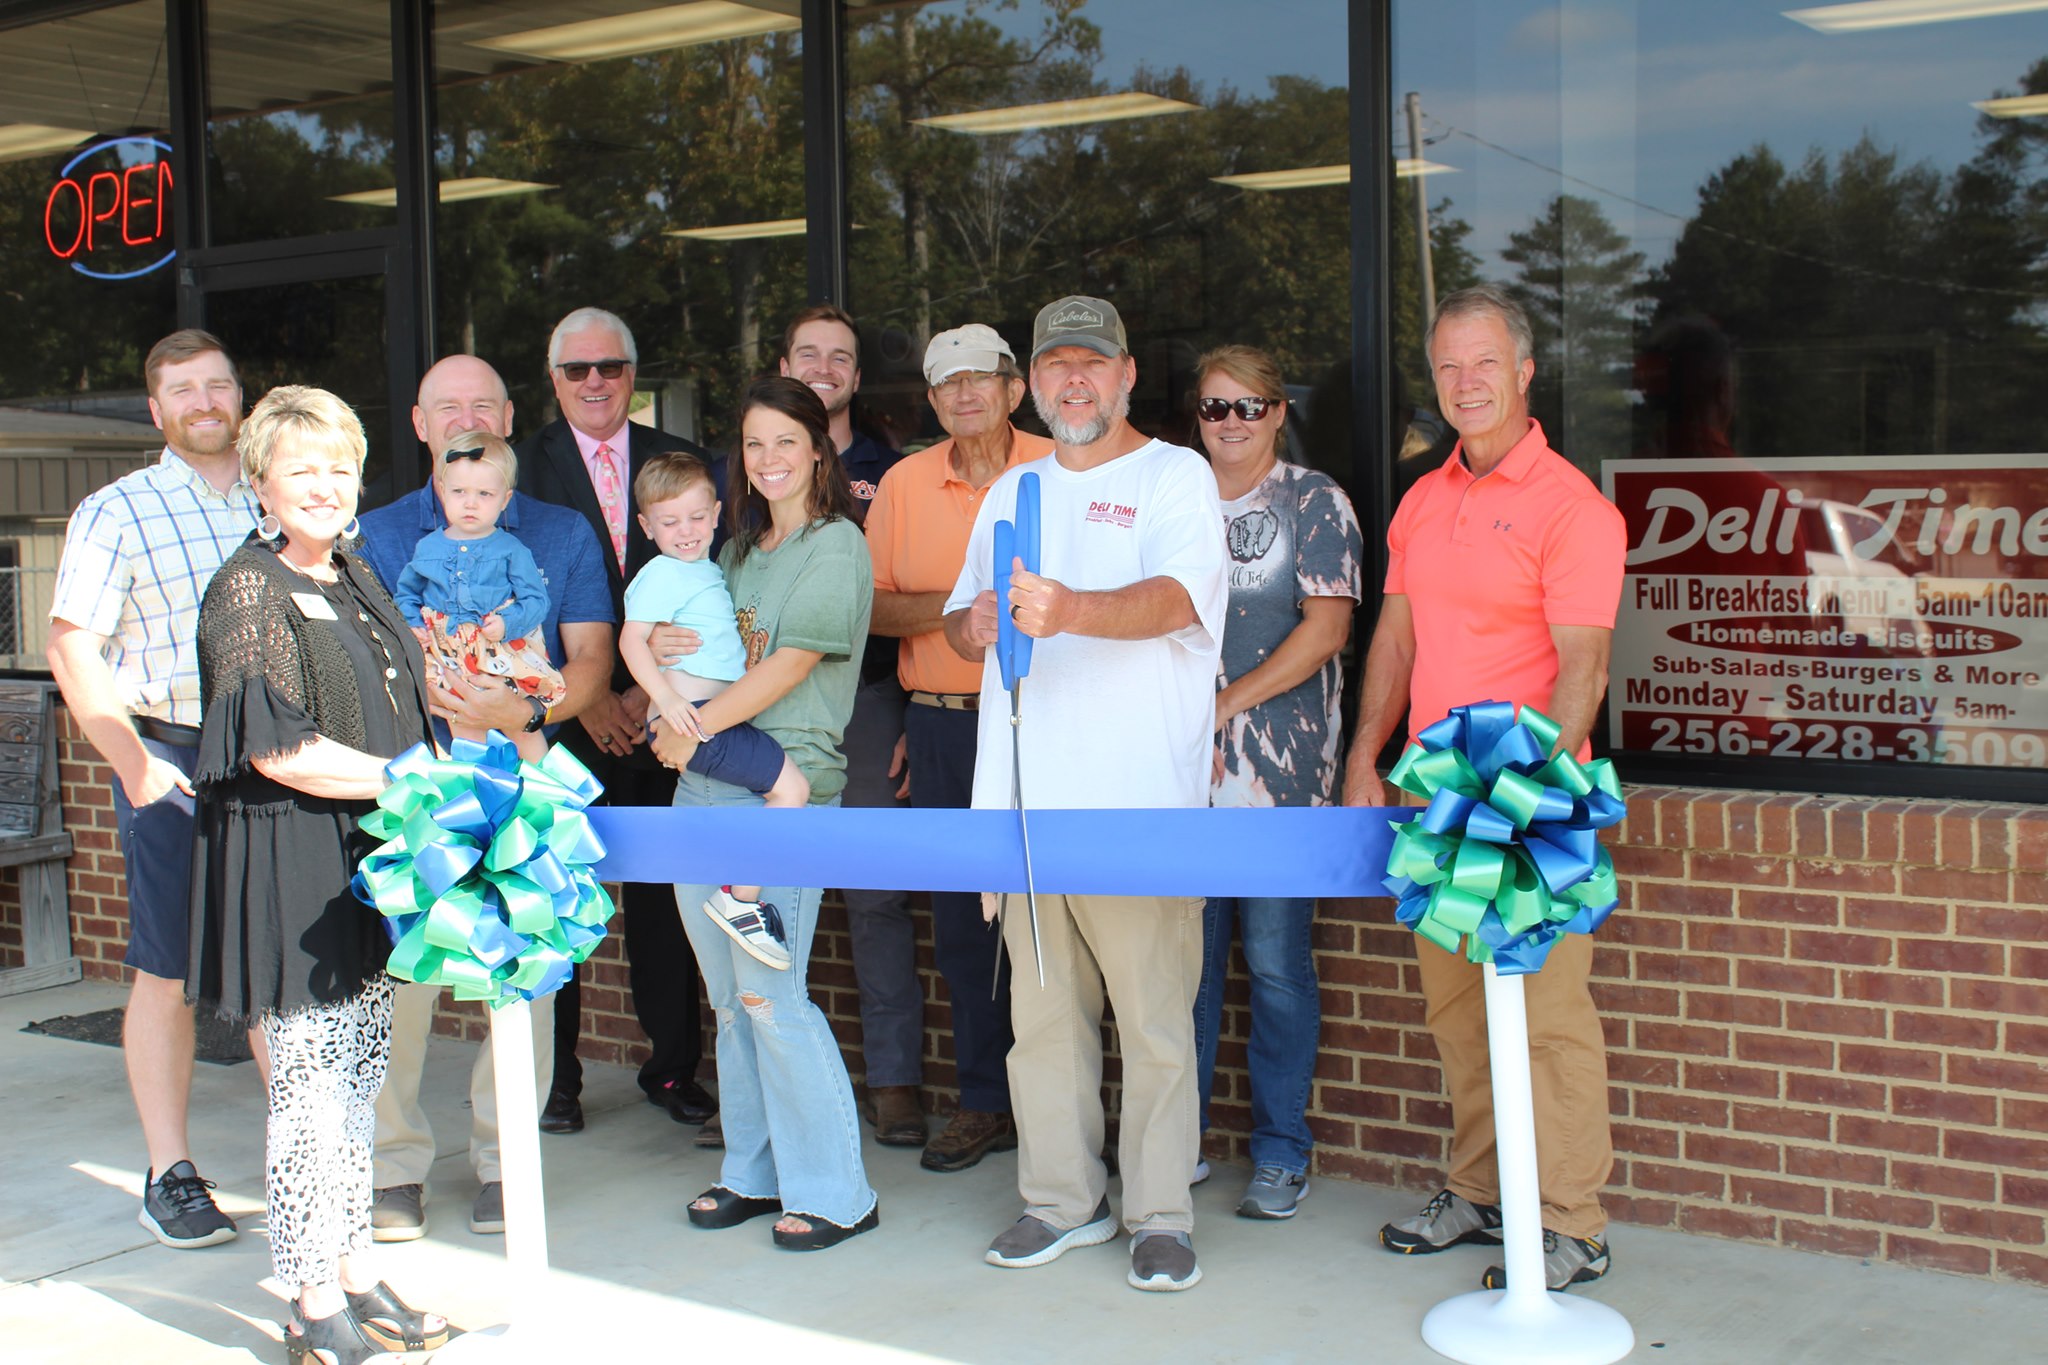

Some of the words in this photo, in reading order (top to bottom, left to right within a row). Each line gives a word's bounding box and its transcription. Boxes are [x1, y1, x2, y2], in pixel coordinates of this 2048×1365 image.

[1089, 501, 1111, 512] DELI
[1113, 504, 1137, 518] TIME
[1625, 487, 1804, 566] Deli
[1636, 577, 1678, 610] Full
[1688, 578, 1809, 614] Breakfast
[1818, 579, 1888, 615] Menu
[1690, 622, 1857, 647] Homemade
[1867, 627, 1996, 651] Biscuits
[1934, 664, 1954, 684] &
[1966, 665, 2040, 686] More
[1626, 678, 1749, 715] Monday
[1786, 683, 1939, 724] Saturday
[1650, 717, 2047, 767] 256-228-3509
